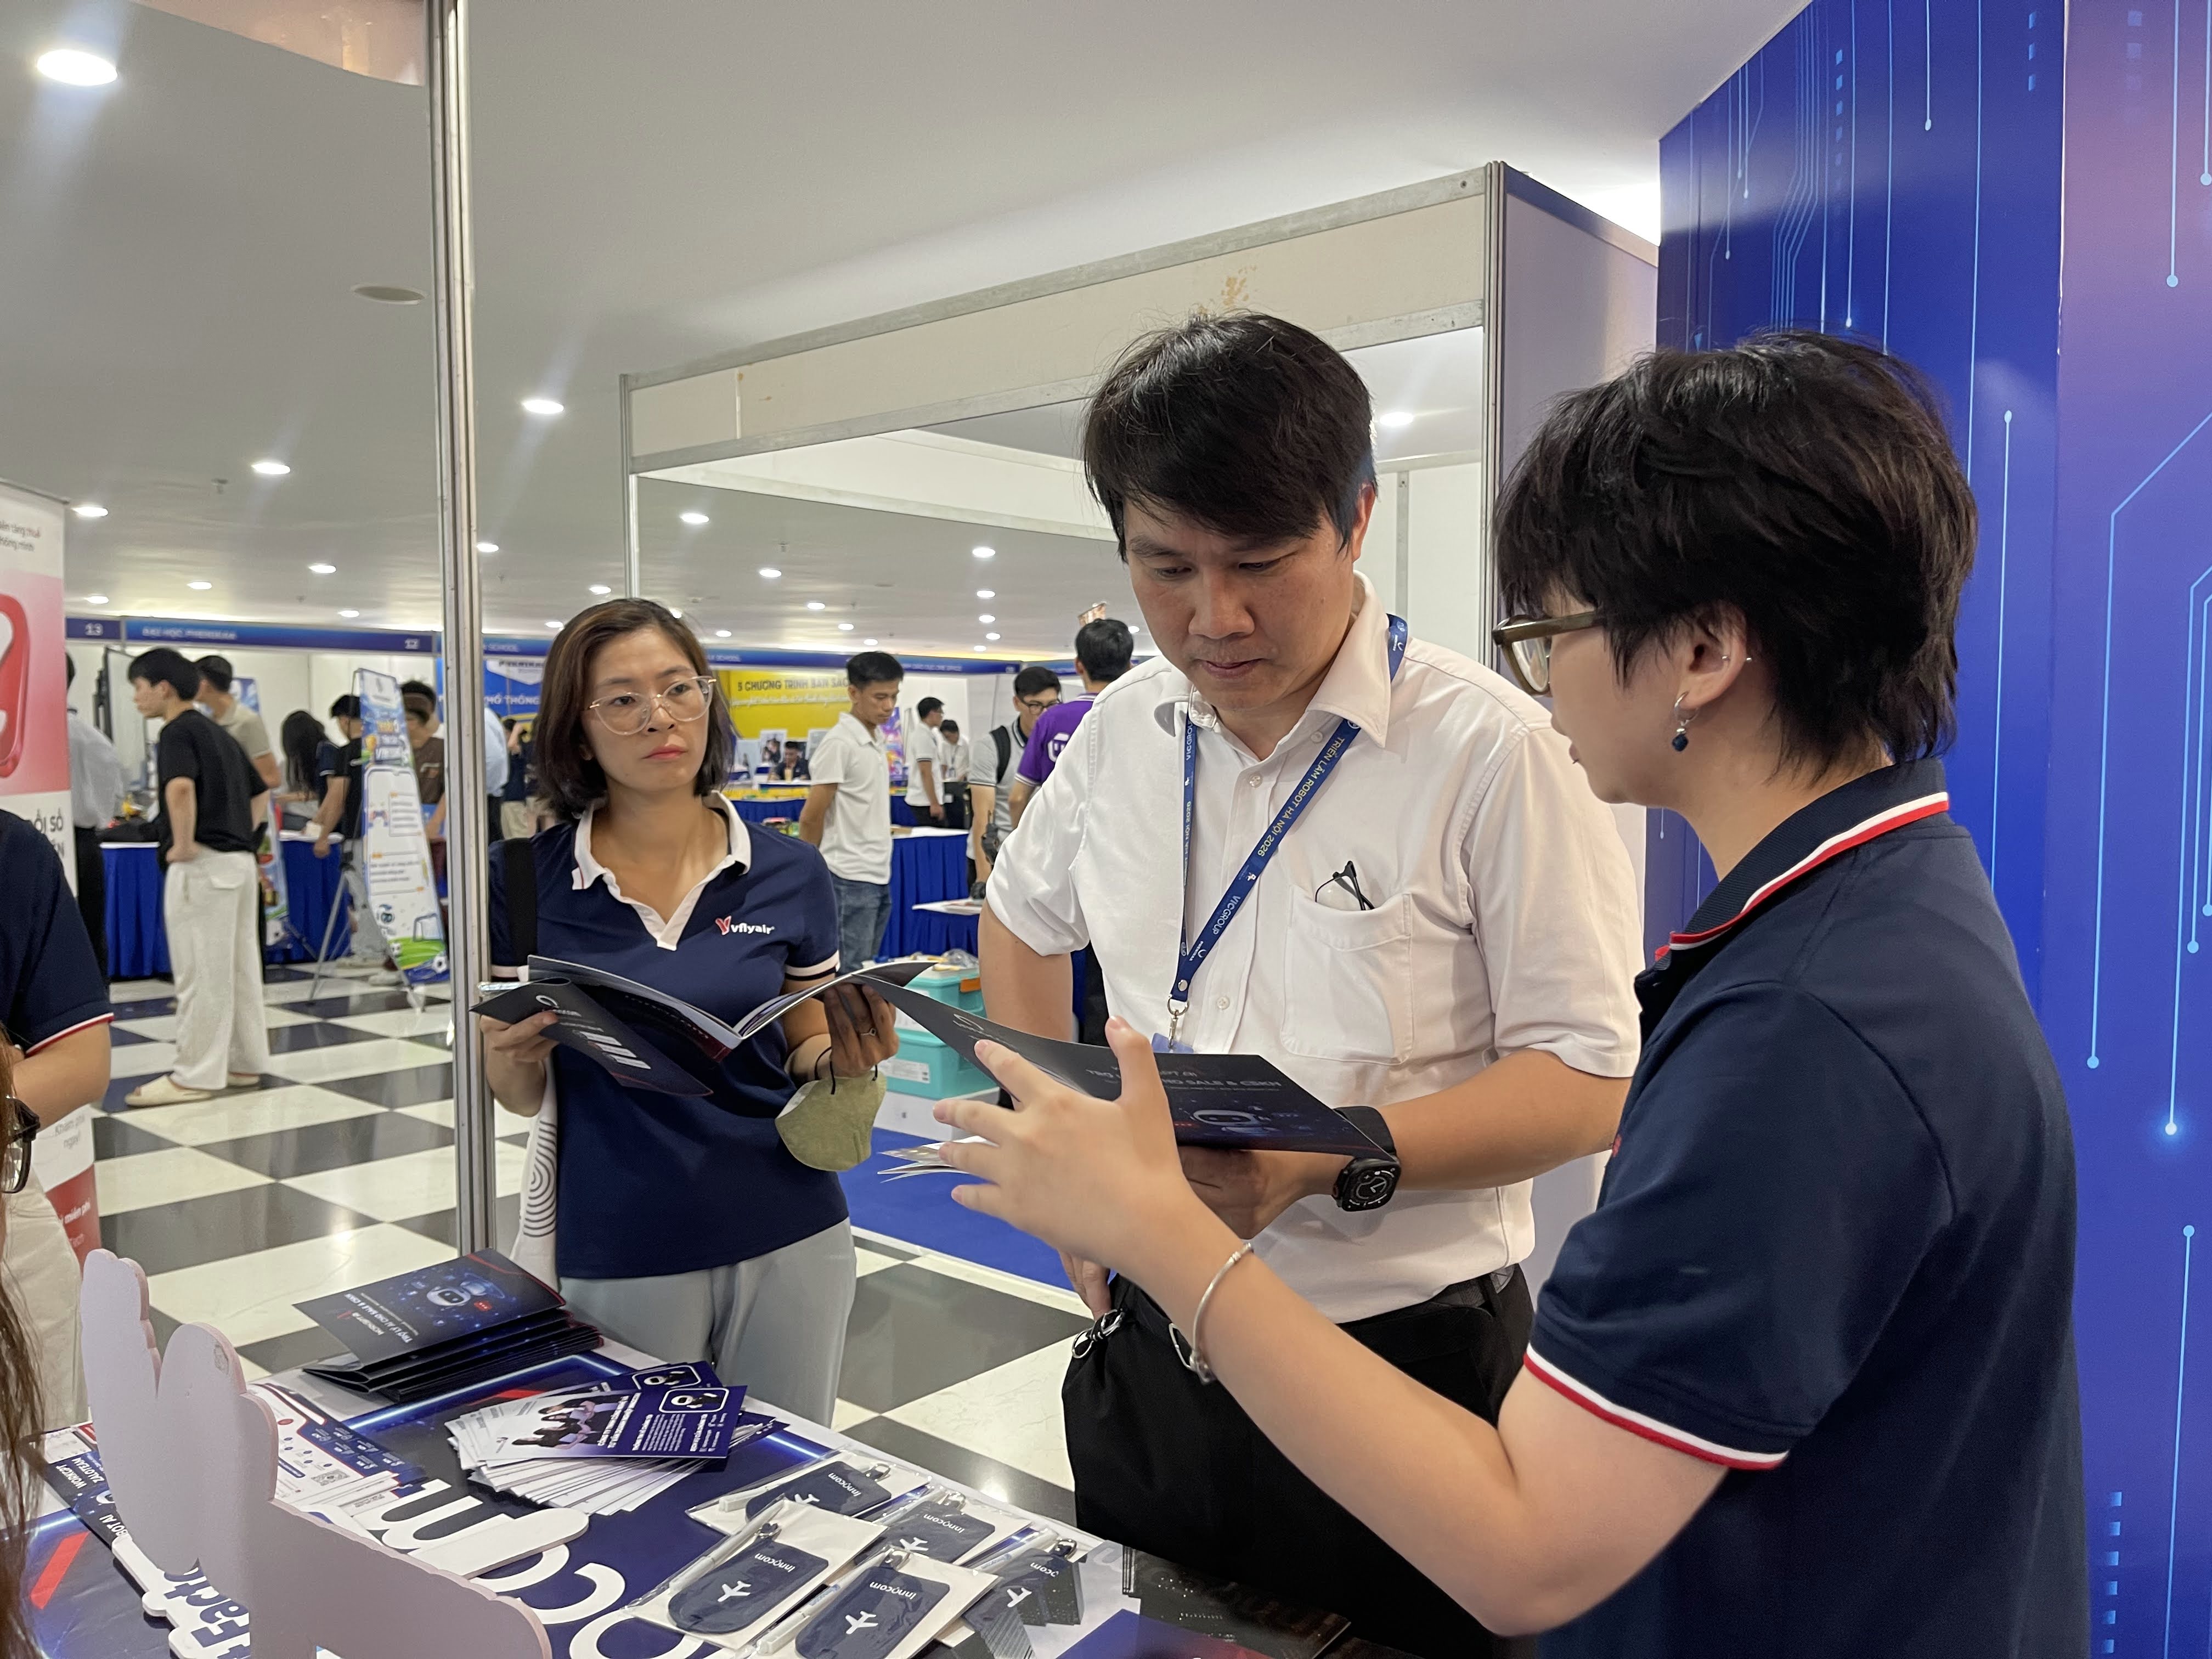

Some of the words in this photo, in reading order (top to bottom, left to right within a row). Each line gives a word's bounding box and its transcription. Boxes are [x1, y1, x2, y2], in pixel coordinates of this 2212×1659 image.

[85, 623, 103, 636] 13
[1292, 778, 1314, 808] ROBOT
[1282, 806, 1296, 820] HÀ
[1271, 819, 1285, 836] NỘI
[1257, 833, 1276, 857] 2026
[1211, 895, 1242, 935] VICGROUP
[730, 922, 772, 935] vflyair
[55, 1464, 87, 1489] WORKGPT
[827, 1471, 862, 1497] Innocom
[923, 1513, 964, 1534] Innocom
[754, 1552, 795, 1573] Innocom
[1030, 1561, 1059, 1576] ocom
[869, 1581, 917, 1600] Innocom
